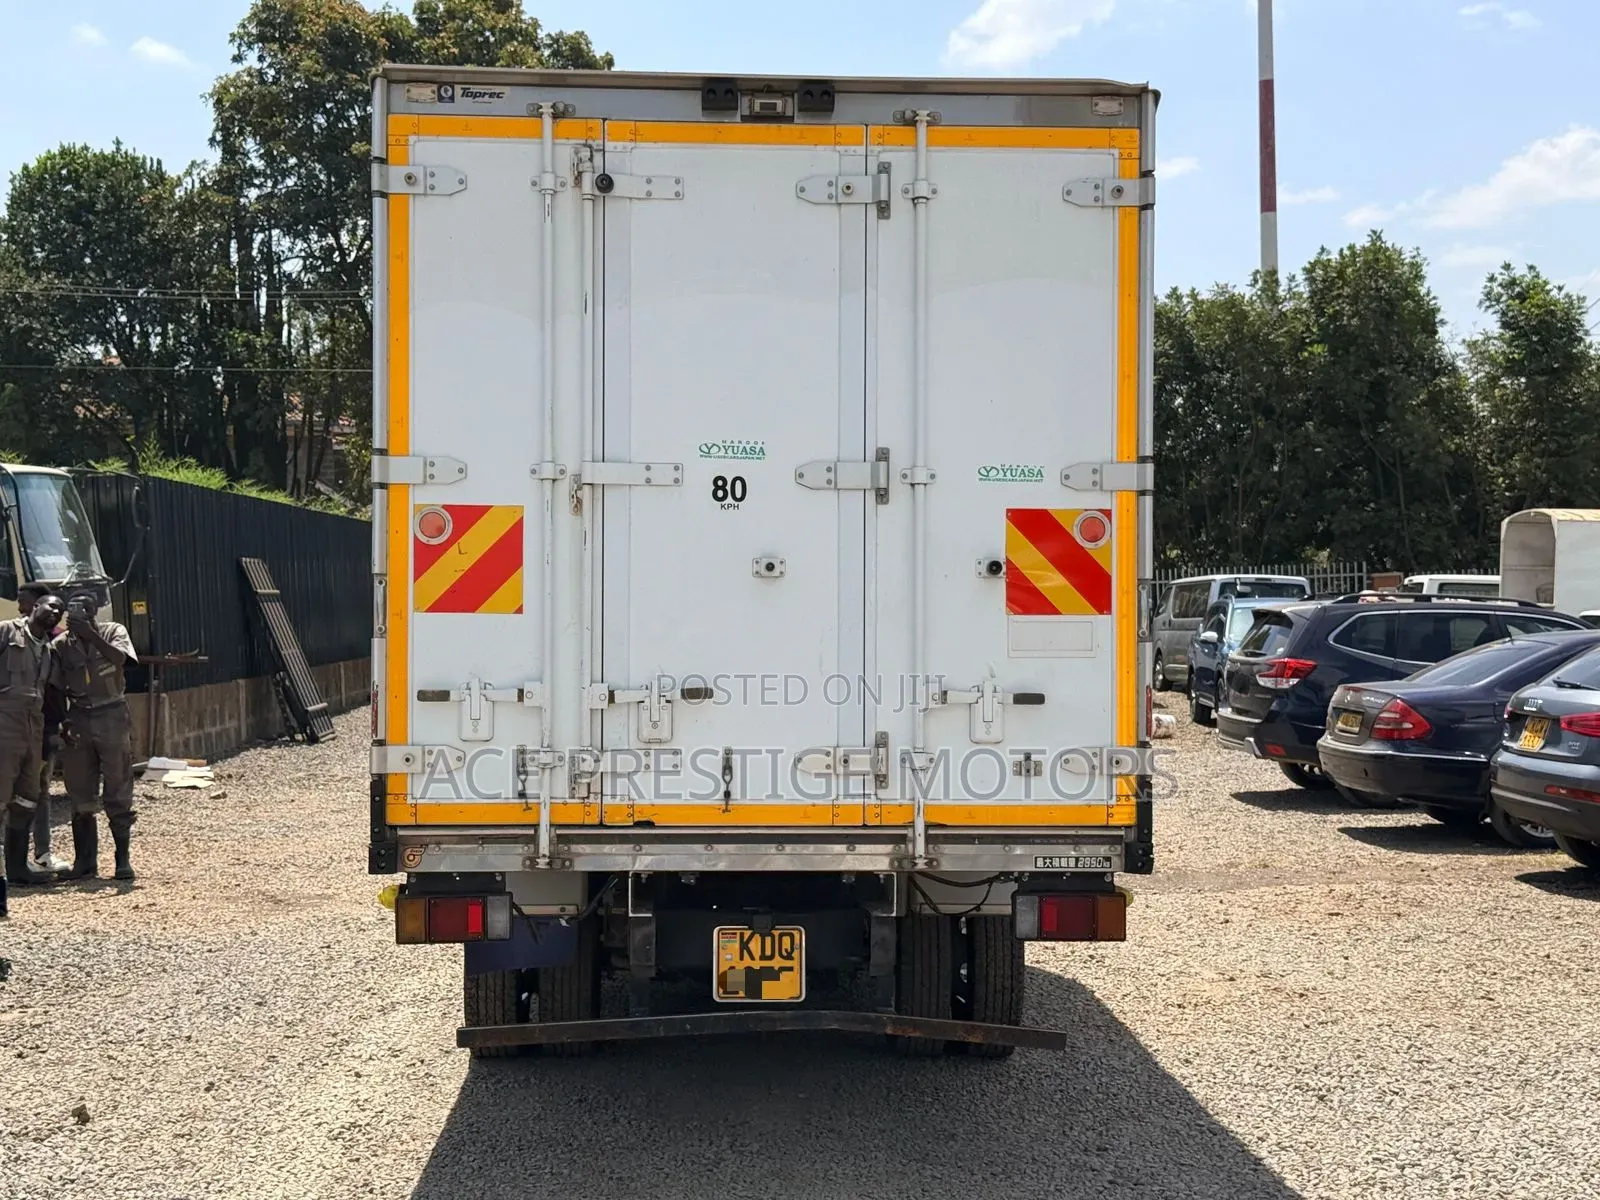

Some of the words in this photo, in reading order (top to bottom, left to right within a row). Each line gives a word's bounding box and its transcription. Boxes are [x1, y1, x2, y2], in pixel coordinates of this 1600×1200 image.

[460, 87, 505, 100] Toprec
[721, 445, 766, 456] YUASA
[1000, 468, 1044, 478] YUASA
[712, 475, 747, 502] 80
[739, 931, 795, 961] KDQ
